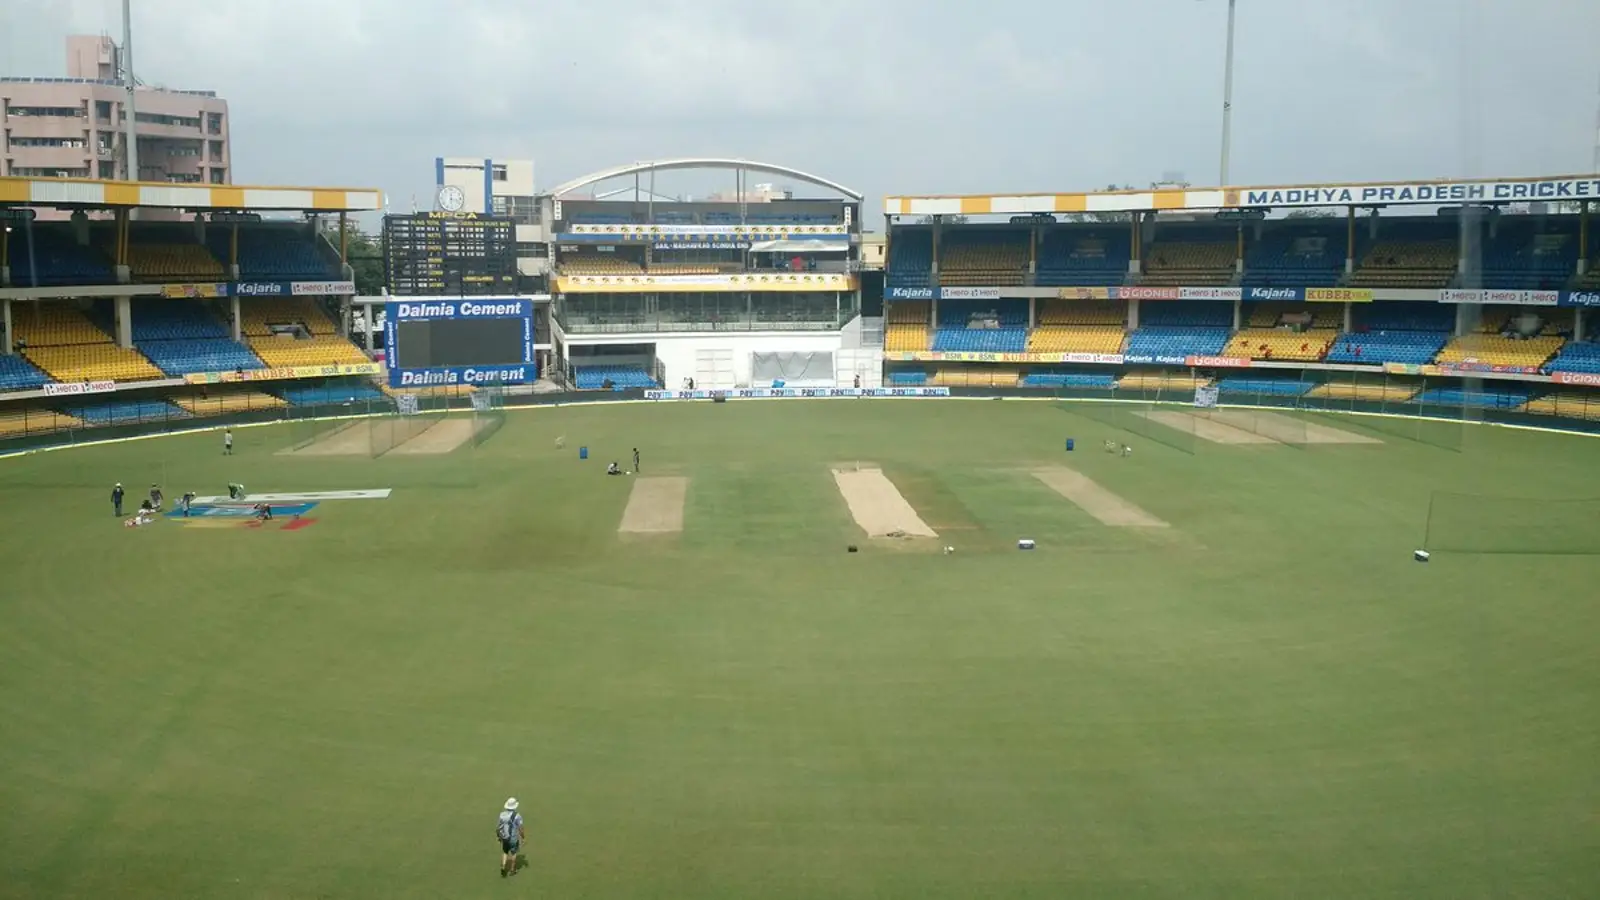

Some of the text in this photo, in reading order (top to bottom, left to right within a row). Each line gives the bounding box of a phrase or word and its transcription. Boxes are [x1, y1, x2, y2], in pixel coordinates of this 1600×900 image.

[1248, 180, 1600, 204] MADHYA PRADESH CRICKET
[428, 211, 478, 220] MPCA
[236, 283, 282, 295] Kajaria
[892, 287, 933, 299] Kajaria
[1131, 287, 1177, 298] GIONEE
[1251, 287, 1297, 299] Kajaria
[1307, 289, 1351, 299] KUBER
[398, 302, 522, 317] Dalmia Cement
[1003, 353, 1041, 361] KUBER
[1155, 355, 1184, 363] Kajaria
[1204, 358, 1241, 366] GIONEE
[252, 368, 296, 379] KUBER
[401, 367, 525, 385] Dalmia Cement
